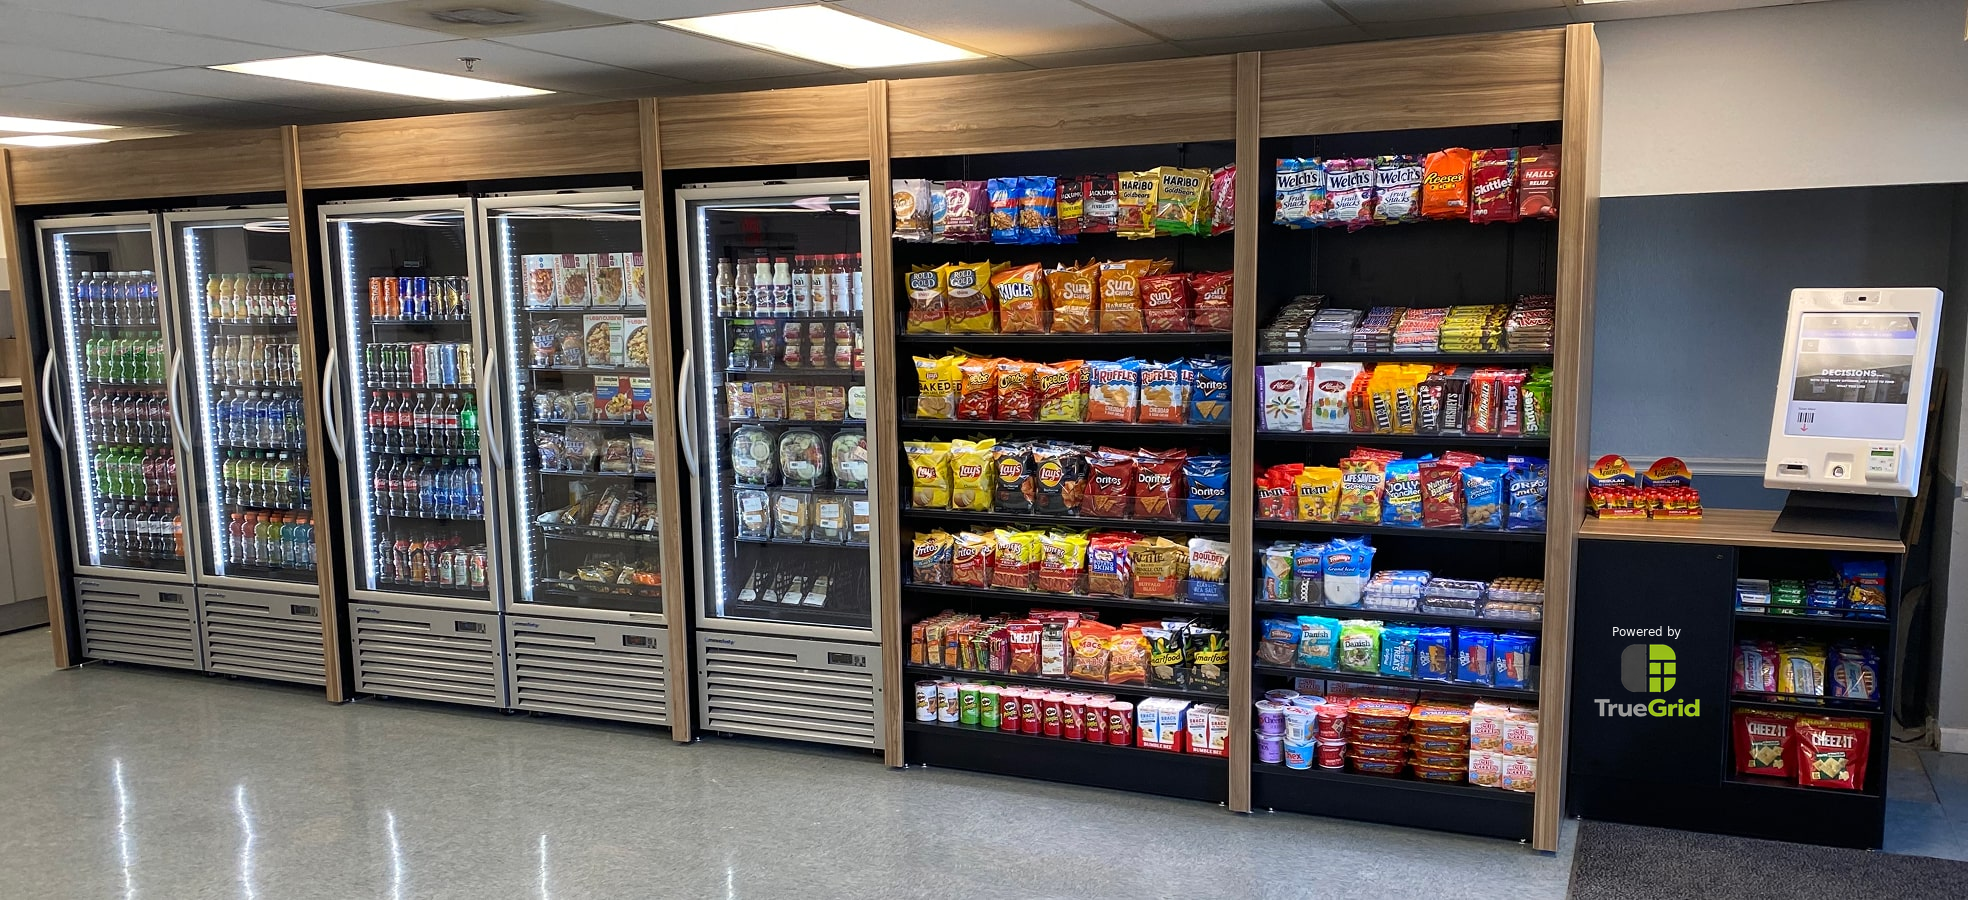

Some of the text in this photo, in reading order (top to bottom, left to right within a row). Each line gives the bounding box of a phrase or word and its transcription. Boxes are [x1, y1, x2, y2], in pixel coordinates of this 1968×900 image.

[1278, 171, 1318, 188] Welch's
[1330, 172, 1370, 188] Welch's
[1380, 168, 1420, 184] Welch's
[1424, 172, 1463, 185] Reese's
[1525, 170, 1554, 178] HALLS
[1121, 180, 1153, 191] HARIBO
[1163, 175, 1199, 188] HARIBO
[1164, 187, 1195, 196] Goldbears
[913, 272, 934, 280] ROLD
[953, 270, 973, 279] ROLD
[911, 279, 936, 290] GOLD
[951, 277, 974, 288] GOLD
[1105, 279, 1135, 297] Sun
[997, 282, 1034, 304] BUGLES
[1063, 282, 1091, 299] Sun
[1150, 291, 1172, 307] Sun
[1100, 369, 1137, 383] RUFFLES
[1142, 370, 1178, 384] RUFFLES
[1822, 369, 1885, 377] DECISIONS...
[919, 382, 951, 391] BAKED
[1040, 372, 1069, 391] Cheetos
[960, 465, 981, 478] Lay's
[1000, 465, 1021, 476] Lay's
[1041, 468, 1061, 480] Lay's
[1138, 474, 1171, 484] Doritos
[1427, 477, 1450, 489] Nutter
[1191, 487, 1225, 496] Doritos
[1390, 480, 1419, 493] JOLLY
[1193, 551, 1225, 566] BOULDER
[1304, 631, 1329, 639] Danish
[1345, 639, 1371, 648] Danish
[1392, 646, 1400, 671] TREATS
